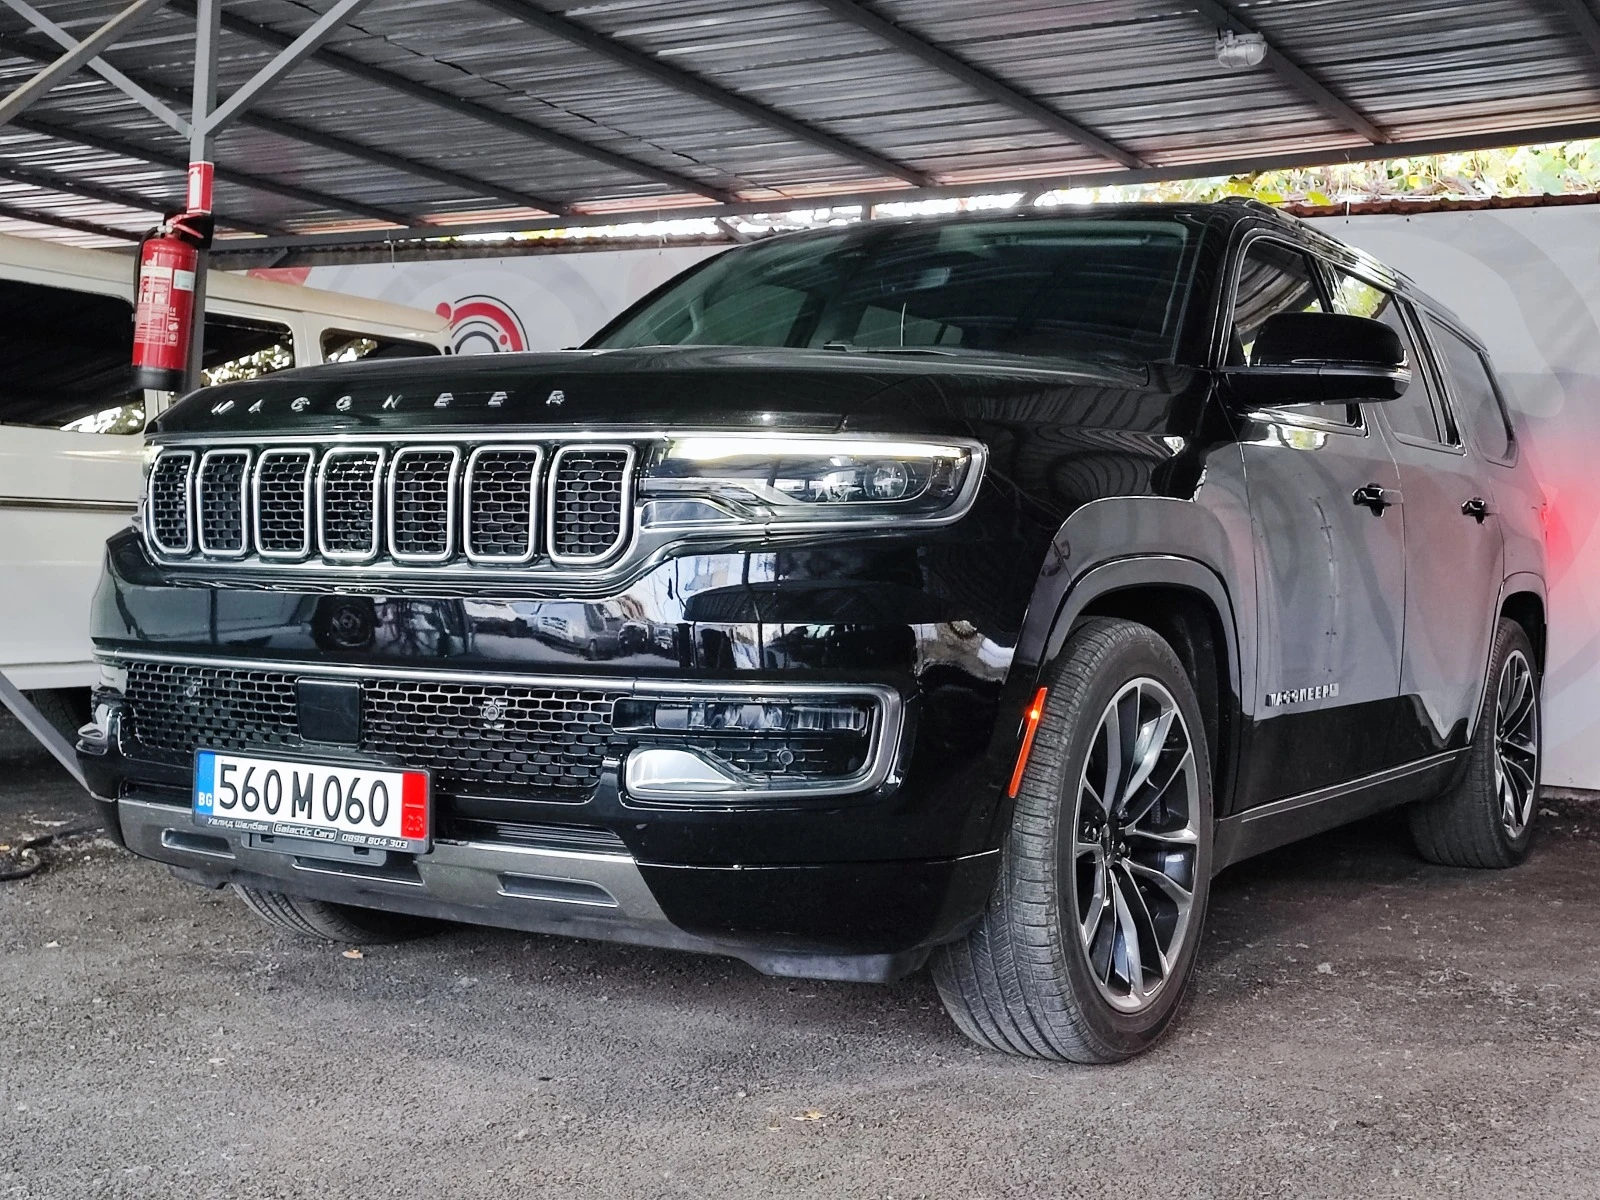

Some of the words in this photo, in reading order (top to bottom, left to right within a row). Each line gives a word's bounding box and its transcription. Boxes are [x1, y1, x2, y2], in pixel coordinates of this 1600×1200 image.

[211, 390, 566, 415] WAGONEER
[198, 791, 213, 807] BG
[219, 763, 283, 815] 560
[291, 770, 314, 820] M
[322, 774, 389, 827] 060
[274, 824, 312, 835] Galactic
[313, 827, 336, 839] Cars
[341, 833, 366, 845] 0898
[367, 836, 387, 847] 804
[388, 839, 408, 850] 303
